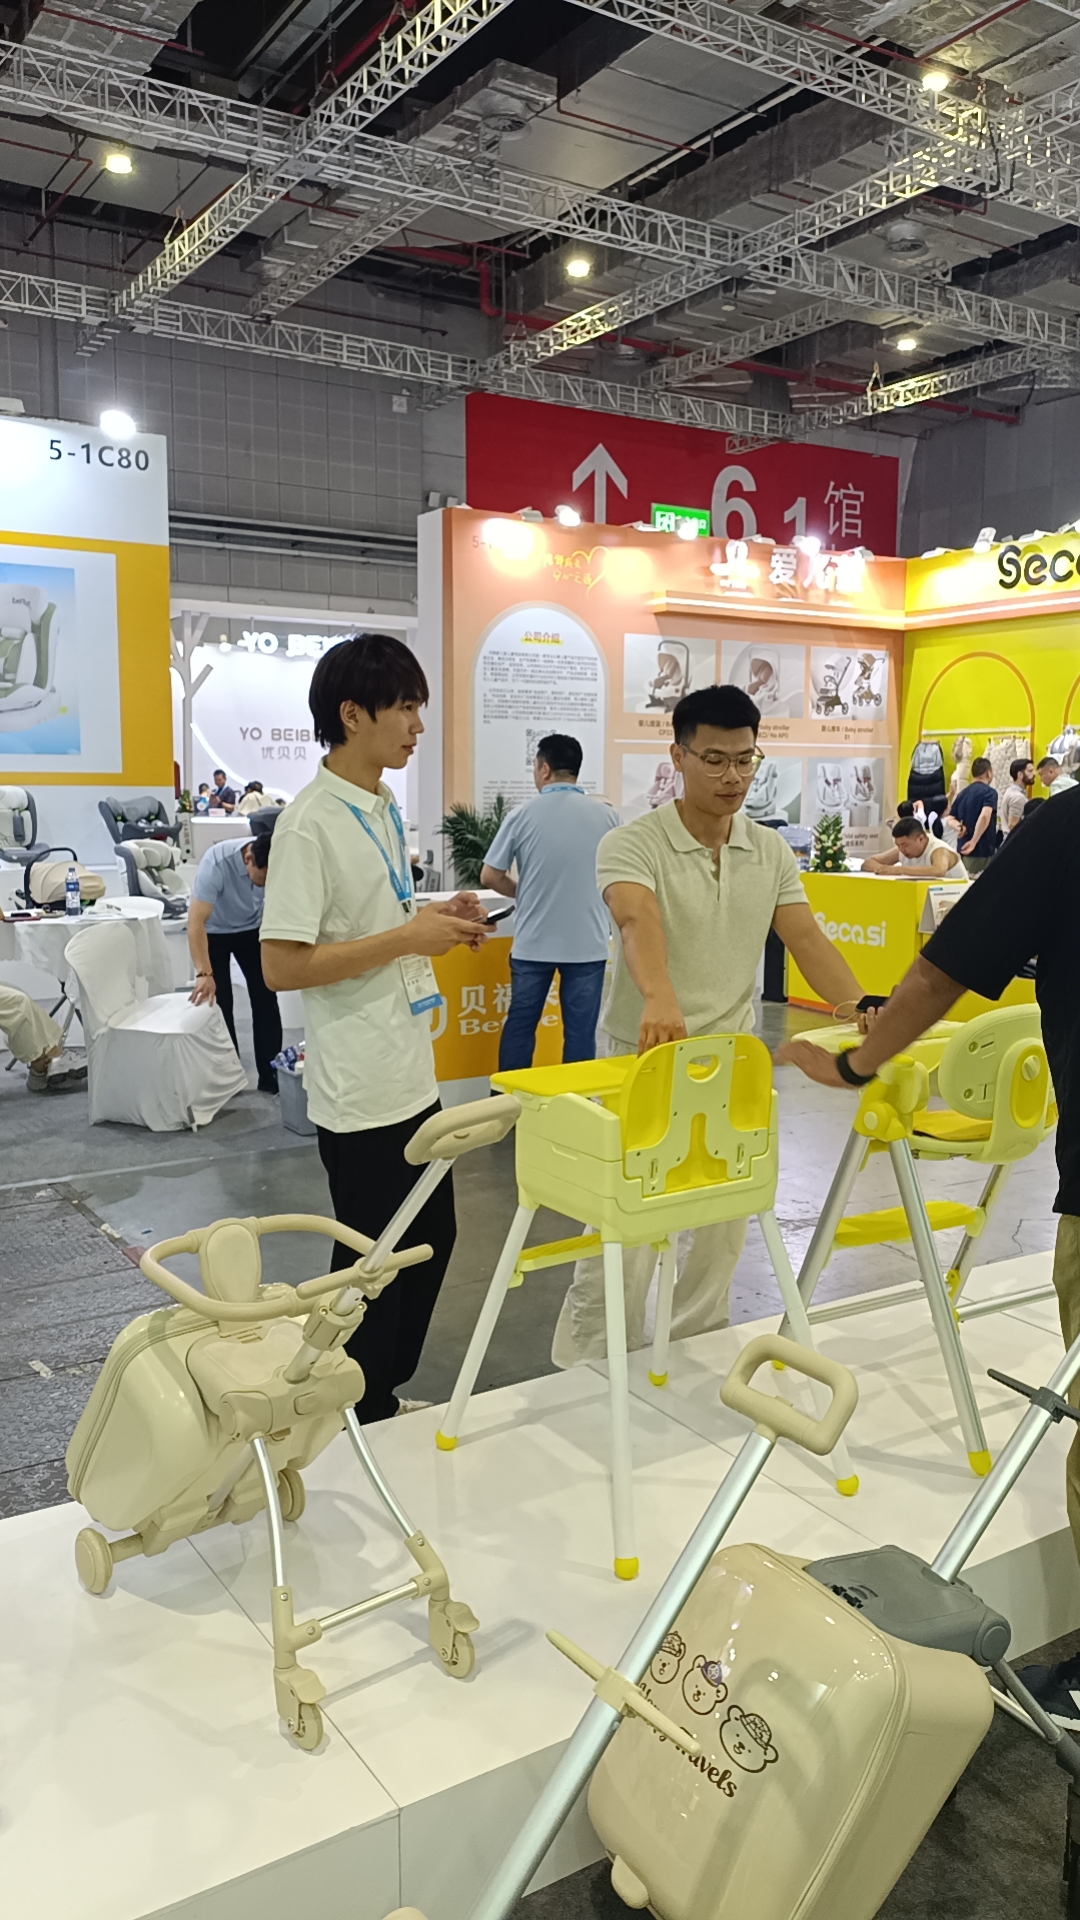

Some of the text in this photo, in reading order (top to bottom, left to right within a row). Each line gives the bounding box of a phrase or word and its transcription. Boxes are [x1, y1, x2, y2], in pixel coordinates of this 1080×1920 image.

[49, 439, 150, 471] 5-1C80
[823, 480, 865, 539] 馆
[239, 726, 315, 742] YO BEIB
[261, 745, 308, 761] 优贝贝
